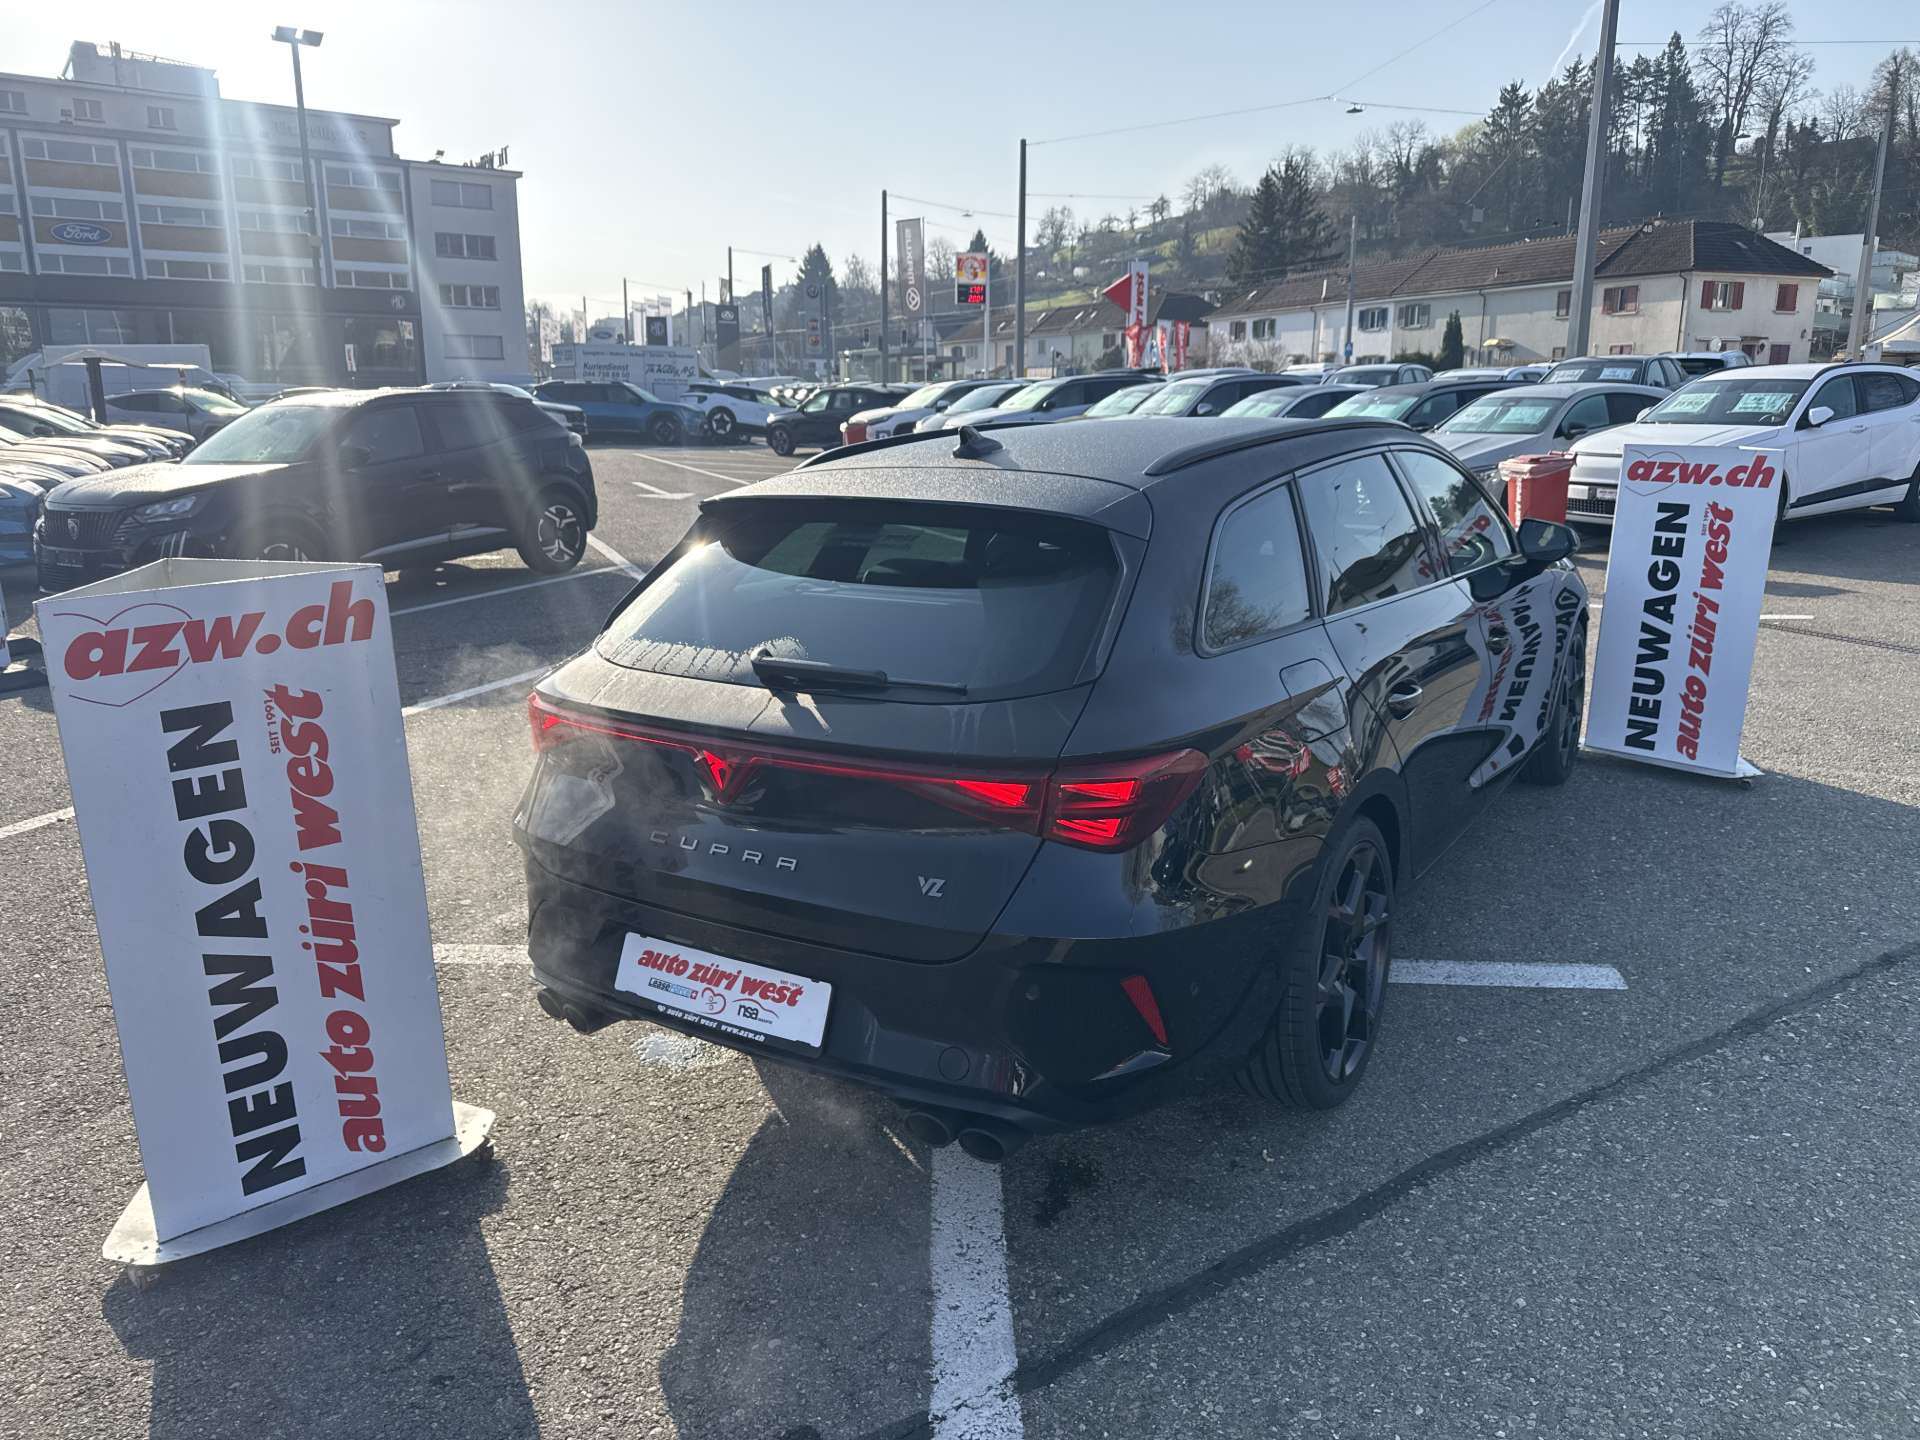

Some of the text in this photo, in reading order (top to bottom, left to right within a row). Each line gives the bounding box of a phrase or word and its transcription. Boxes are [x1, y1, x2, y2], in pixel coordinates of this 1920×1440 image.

[63, 225, 101, 241] Ford
[1627, 455, 1775, 489] azw.ch
[64, 580, 375, 681] azw.ch
[1624, 501, 1690, 752] NEUWAGEN
[1676, 501, 1734, 761] auto züri west
[263, 699, 281, 754] SEIT 1991
[650, 830, 797, 871] CUPRA
[918, 875, 946, 898] VZ
[263, 683, 386, 1154] auto züri west
[160, 700, 307, 1197] NEUWAGEN
[637, 948, 804, 1007] auto züri west
[737, 1004, 759, 1021] nsa
